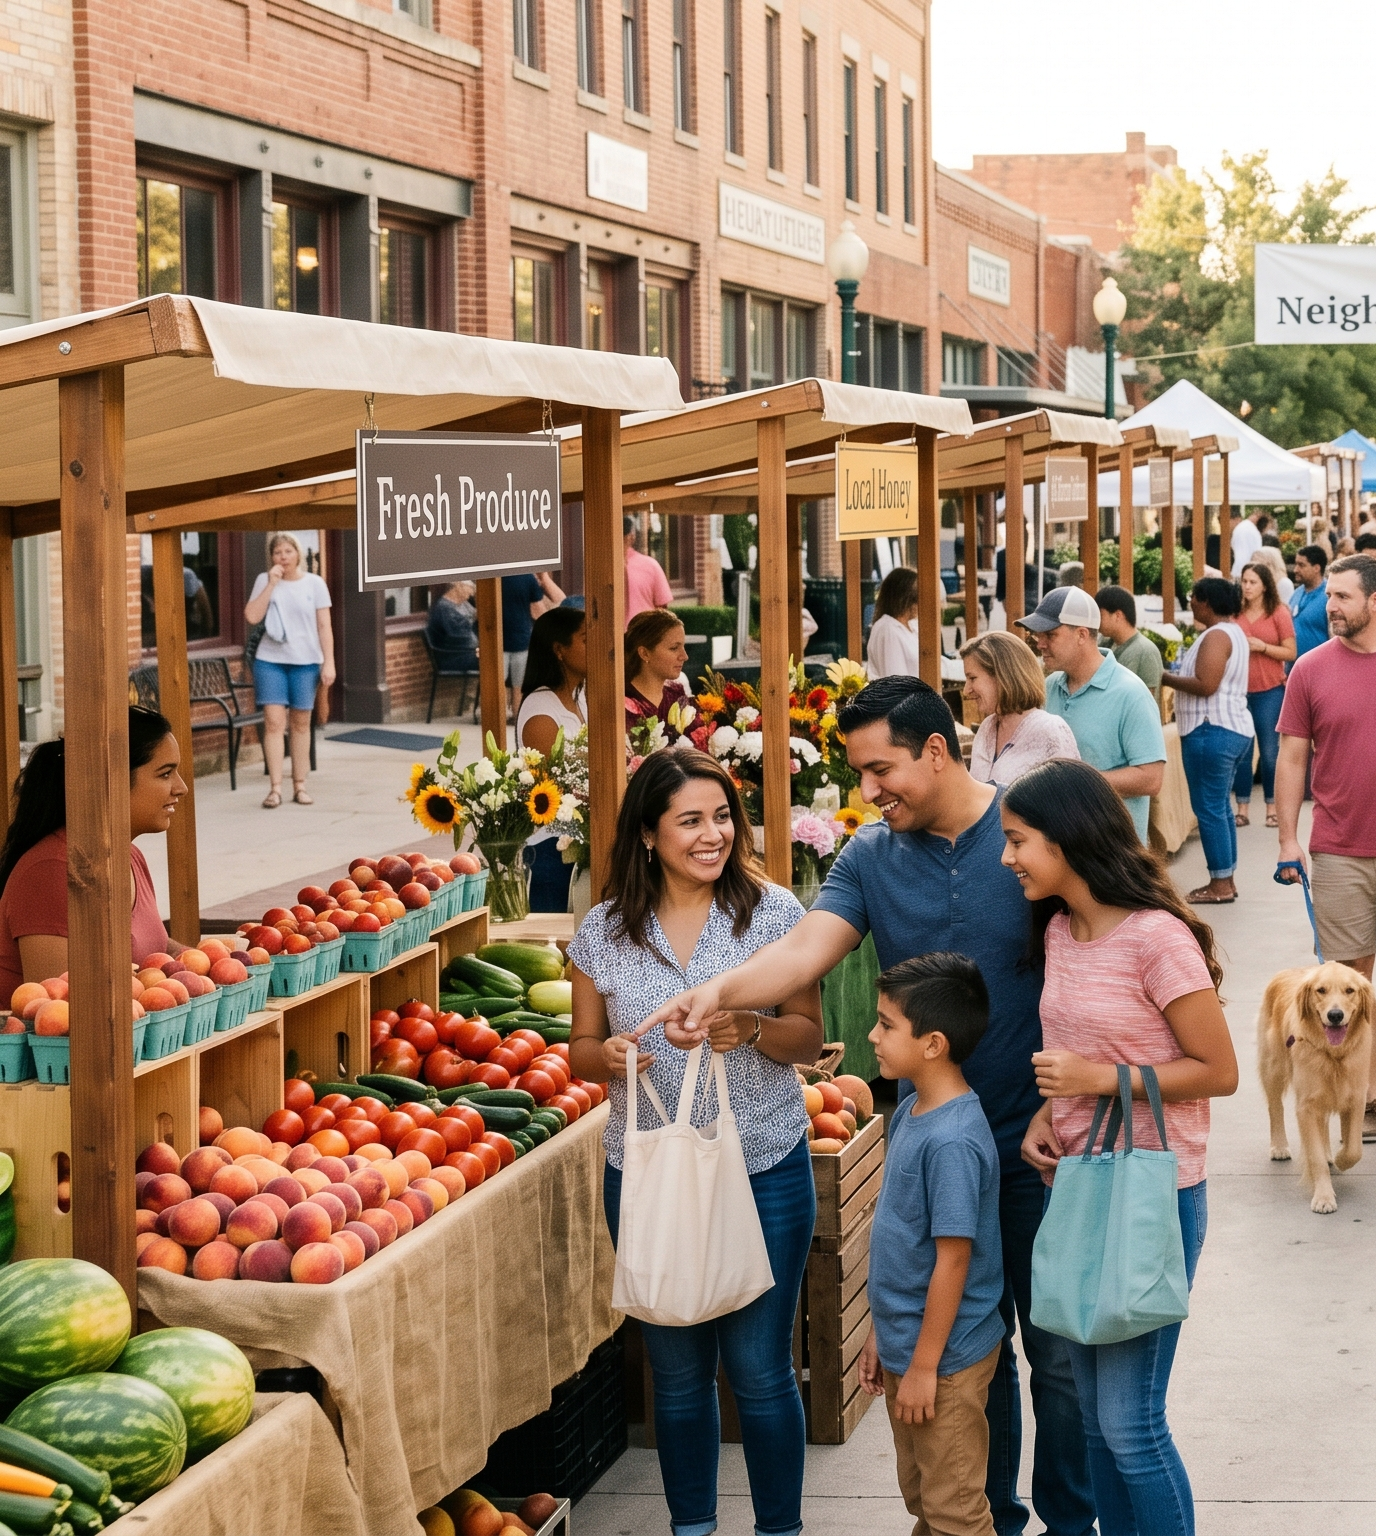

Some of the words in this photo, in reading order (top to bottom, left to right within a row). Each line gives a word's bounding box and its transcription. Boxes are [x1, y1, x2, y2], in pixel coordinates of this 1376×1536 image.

[376, 473, 453, 541] Fresh
[458, 472, 551, 535] Produce
[845, 467, 876, 511] Local
[878, 468, 911, 520] Honey
